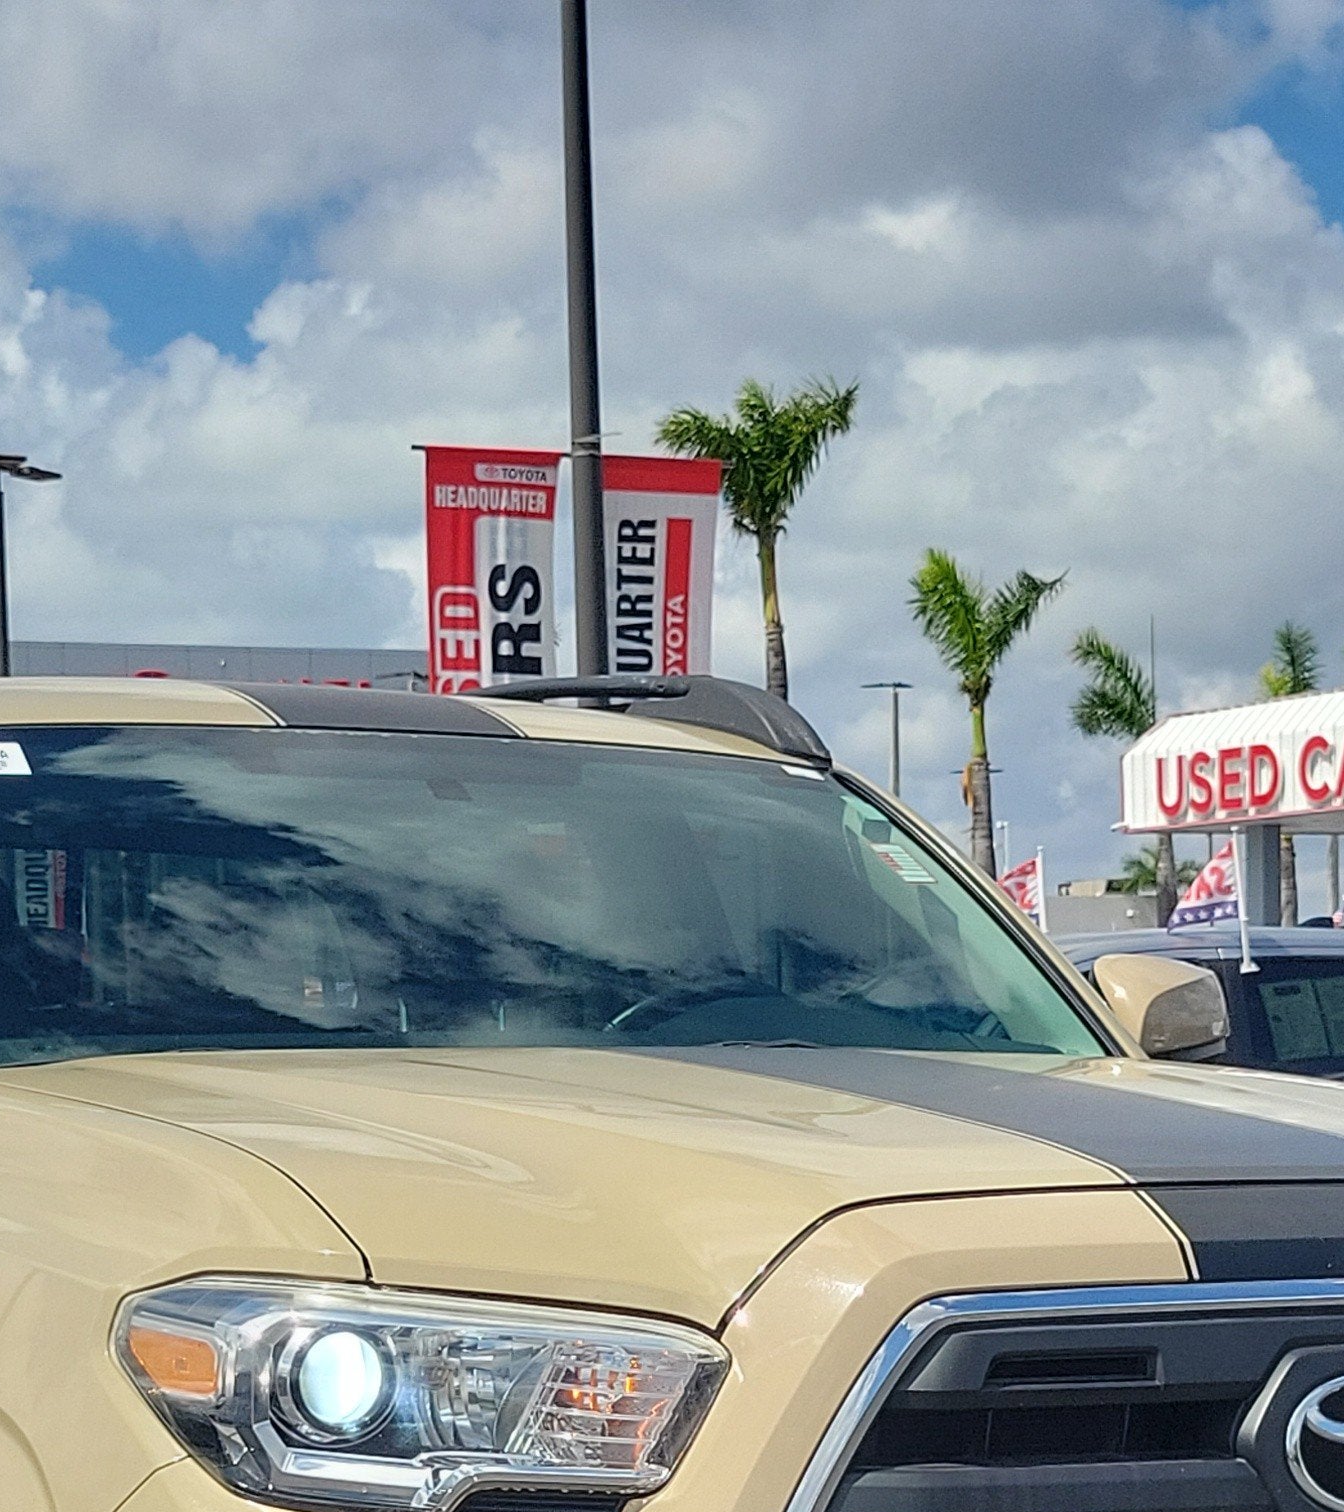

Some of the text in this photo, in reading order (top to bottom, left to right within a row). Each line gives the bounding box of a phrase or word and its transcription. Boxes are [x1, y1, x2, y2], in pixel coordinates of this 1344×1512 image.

[502, 467, 548, 482] TOYOTA
[434, 484, 547, 514] HEADQUARTER
[1156, 744, 1280, 818] USED
